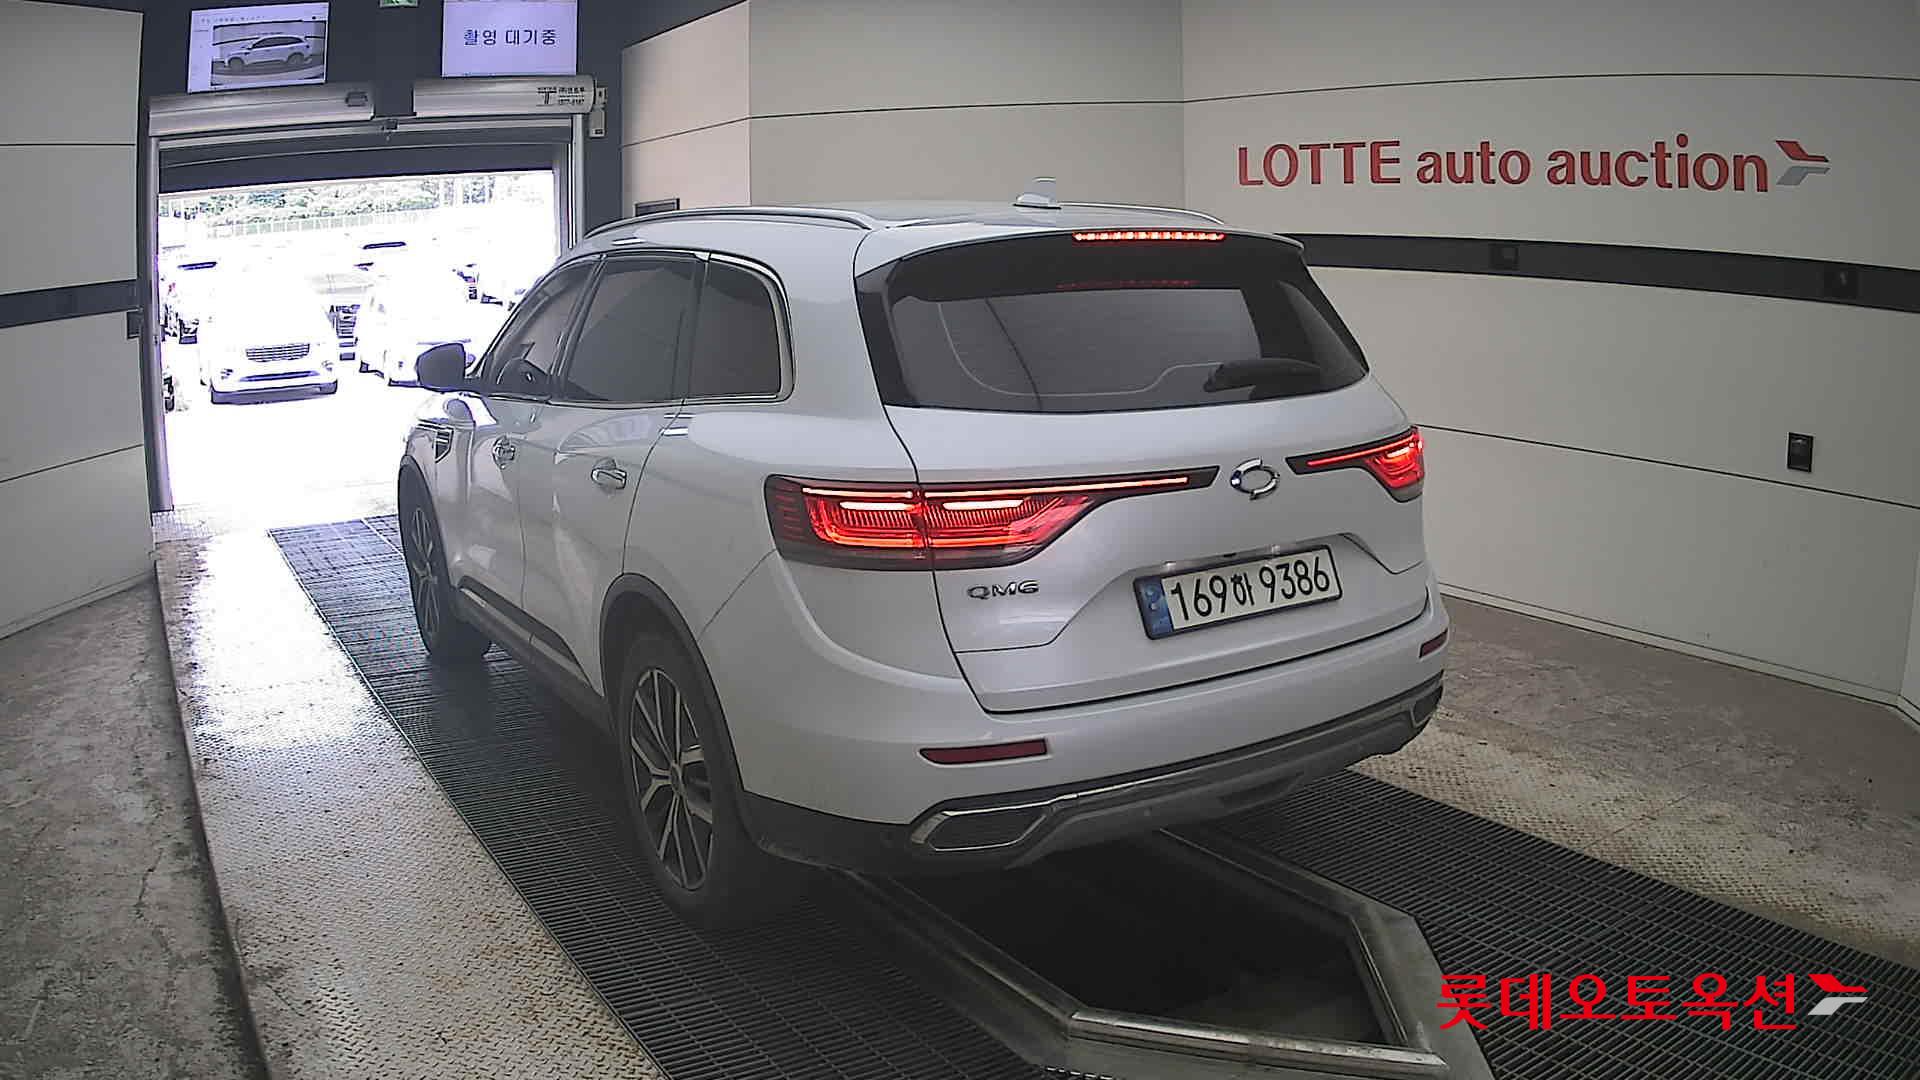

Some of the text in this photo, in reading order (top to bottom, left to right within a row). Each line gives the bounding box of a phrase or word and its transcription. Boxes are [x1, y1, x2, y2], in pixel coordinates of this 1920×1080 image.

[464, 29, 556, 46] 촬영 대기중
[1238, 133, 1769, 193] LOTTE auto auction
[968, 580, 1039, 600] QM6
[1171, 556, 1330, 620] 169하 9386
